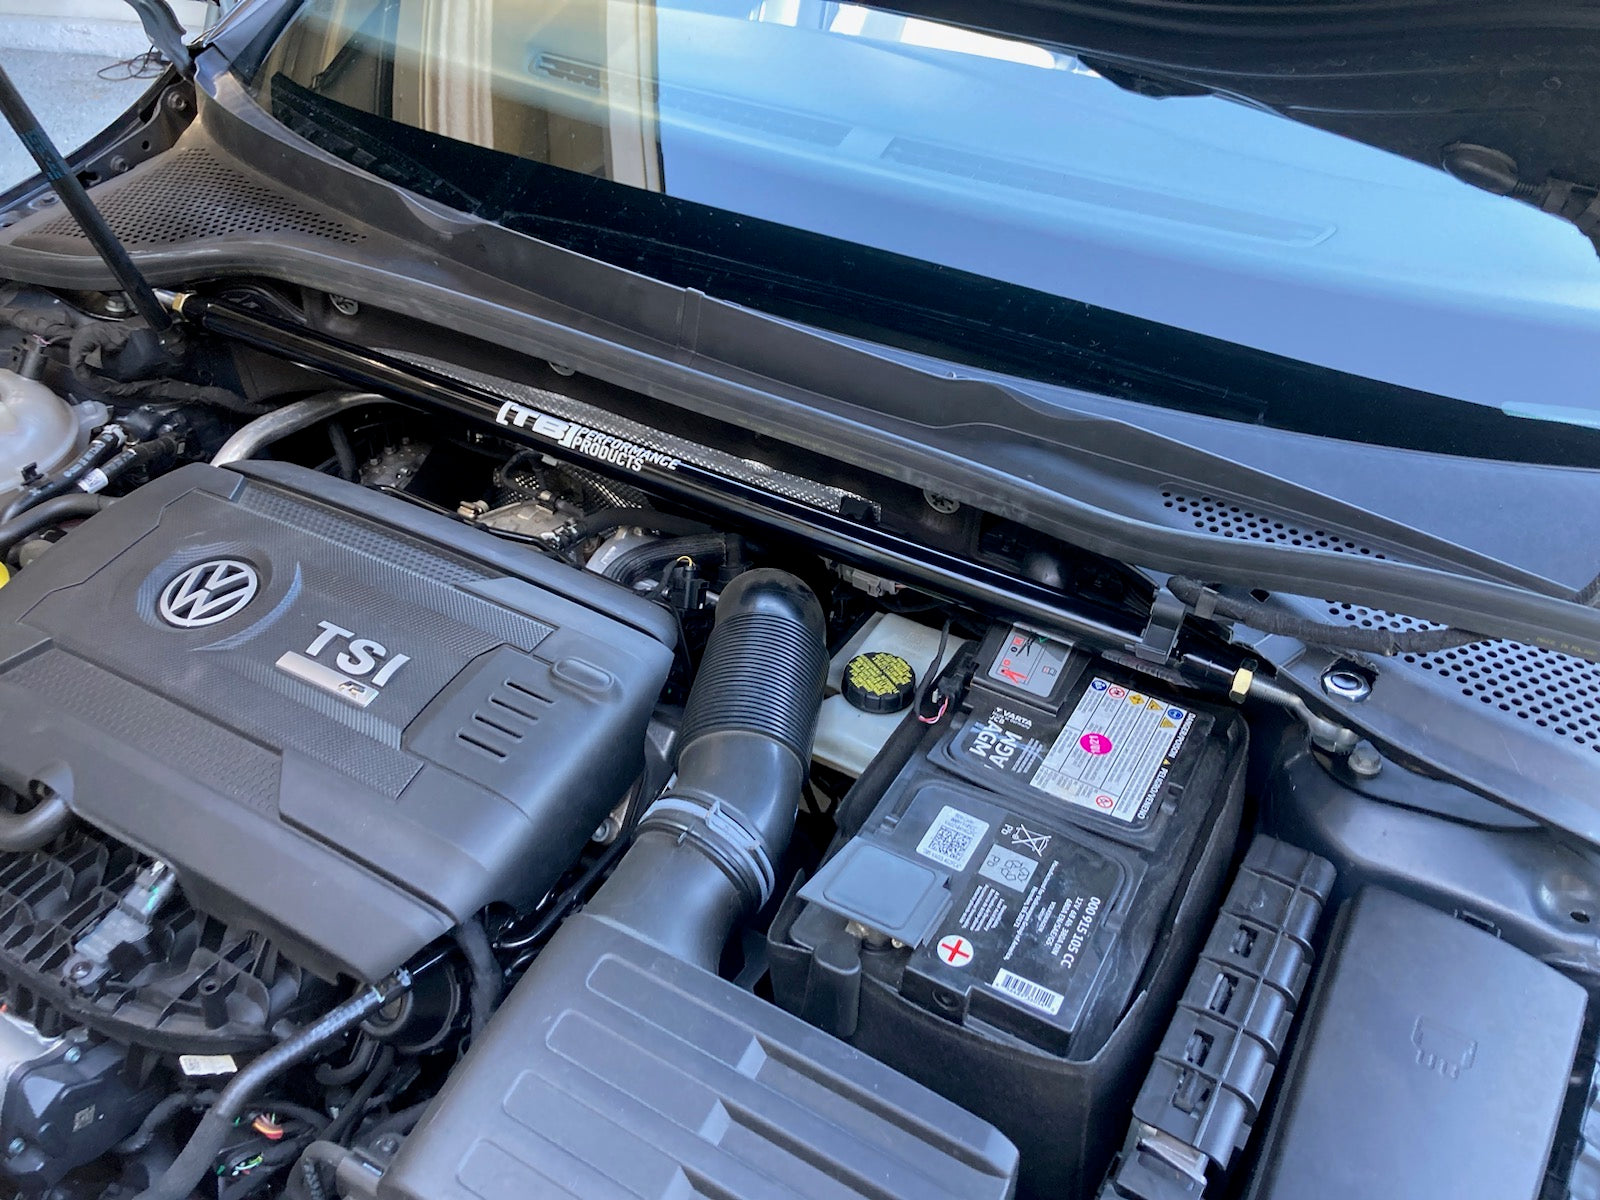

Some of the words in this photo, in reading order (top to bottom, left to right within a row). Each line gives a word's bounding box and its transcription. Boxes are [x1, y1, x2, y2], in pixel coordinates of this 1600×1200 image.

[572, 437, 646, 472] PRODUCTS
[577, 426, 682, 471] PERFORMANCE
[304, 620, 411, 688] TSI
[1003, 709, 1033, 727] VARTA
[968, 720, 1003, 758] AGM
[988, 730, 1023, 769] AGM
[1001, 823, 1013, 835] Pb
[986, 854, 1000, 868] Pb
[1072, 896, 1083, 910] 12V
[1085, 896, 1100, 915] 000
[1075, 914, 1092, 934] 915
[1067, 933, 1083, 953] 105
[1060, 952, 1074, 968] CC
